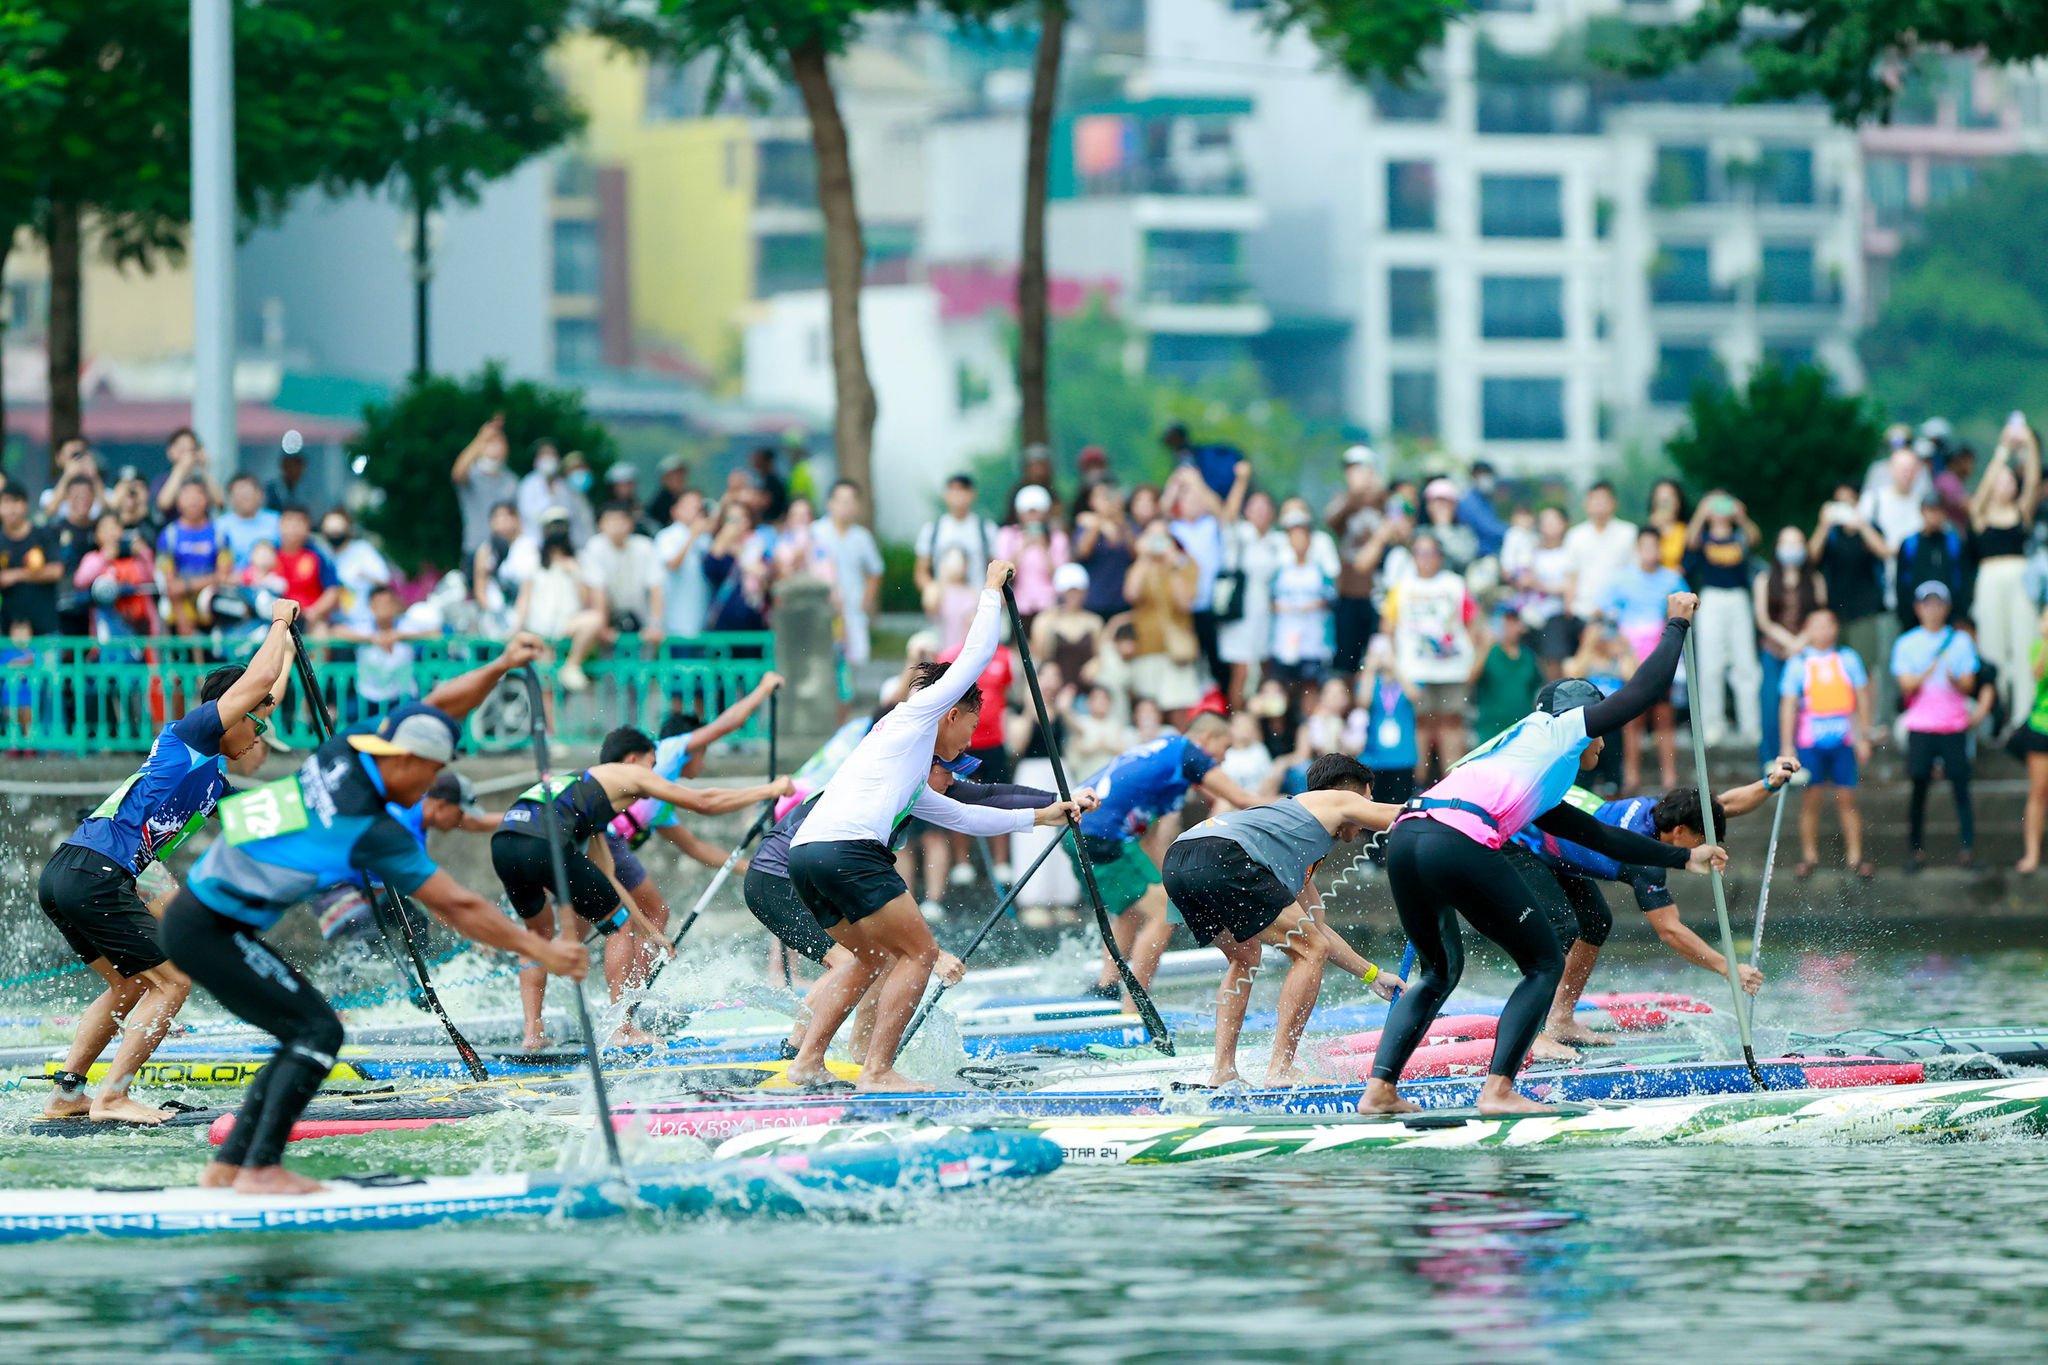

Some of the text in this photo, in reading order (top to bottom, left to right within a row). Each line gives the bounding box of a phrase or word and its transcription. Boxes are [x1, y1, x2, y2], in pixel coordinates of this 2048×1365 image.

[650, 1116, 808, 1138] 426X58X15CM
[1061, 1147, 1118, 1160] STAR 24
